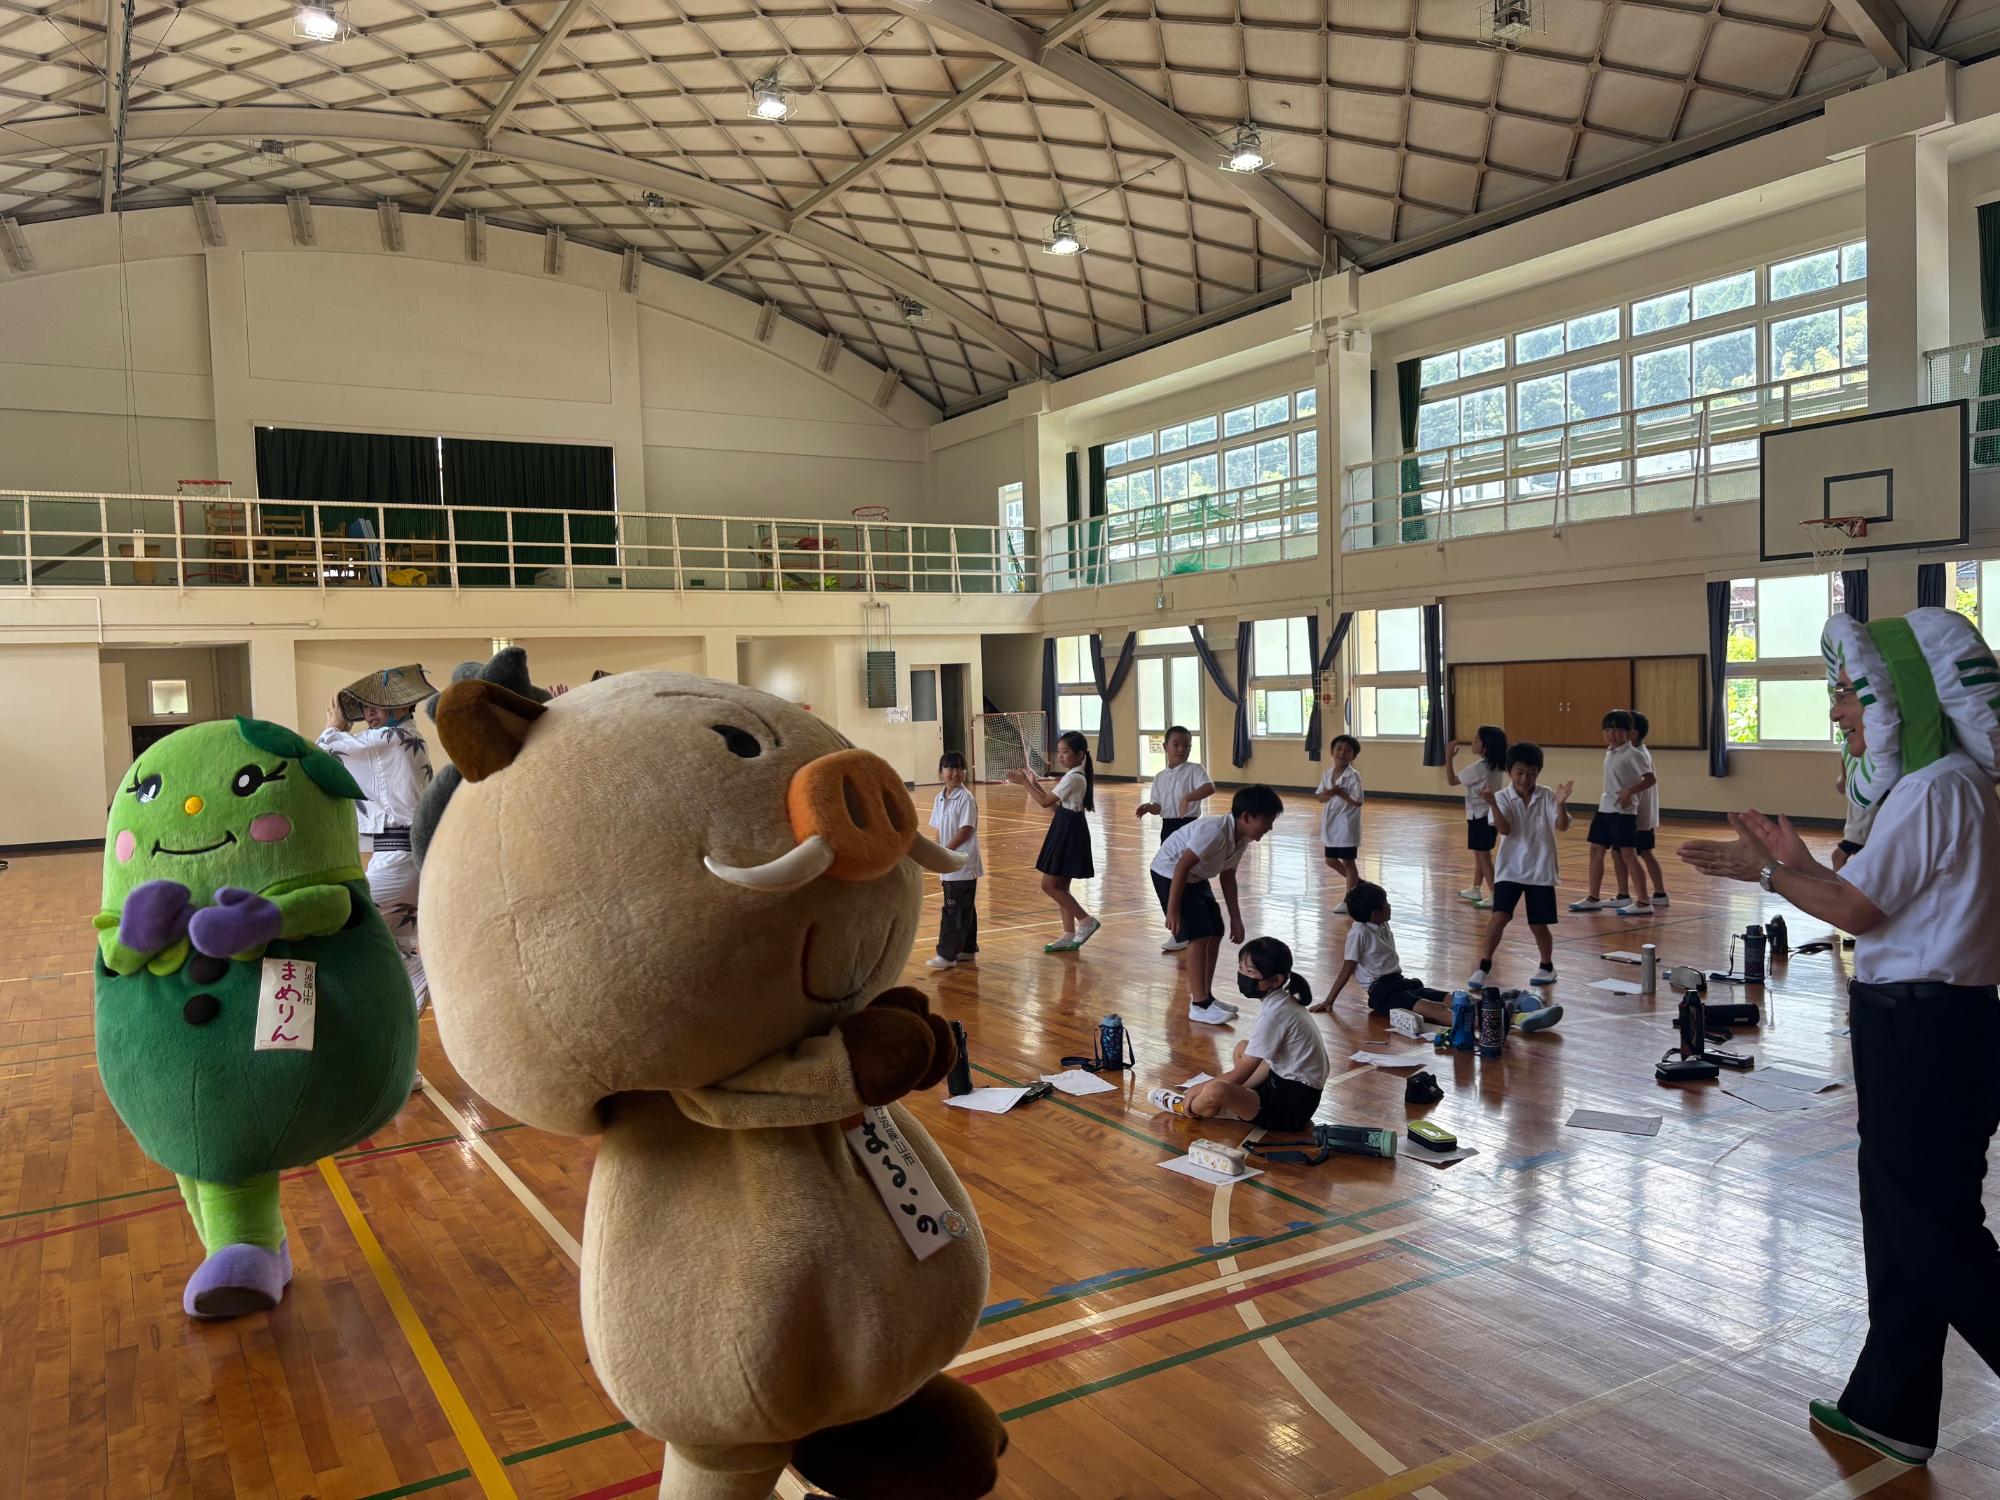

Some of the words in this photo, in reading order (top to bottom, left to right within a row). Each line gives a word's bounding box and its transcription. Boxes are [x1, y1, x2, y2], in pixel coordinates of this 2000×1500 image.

[271, 961, 302, 1041] まめりん
[861, 1119, 939, 1235] まるいの
